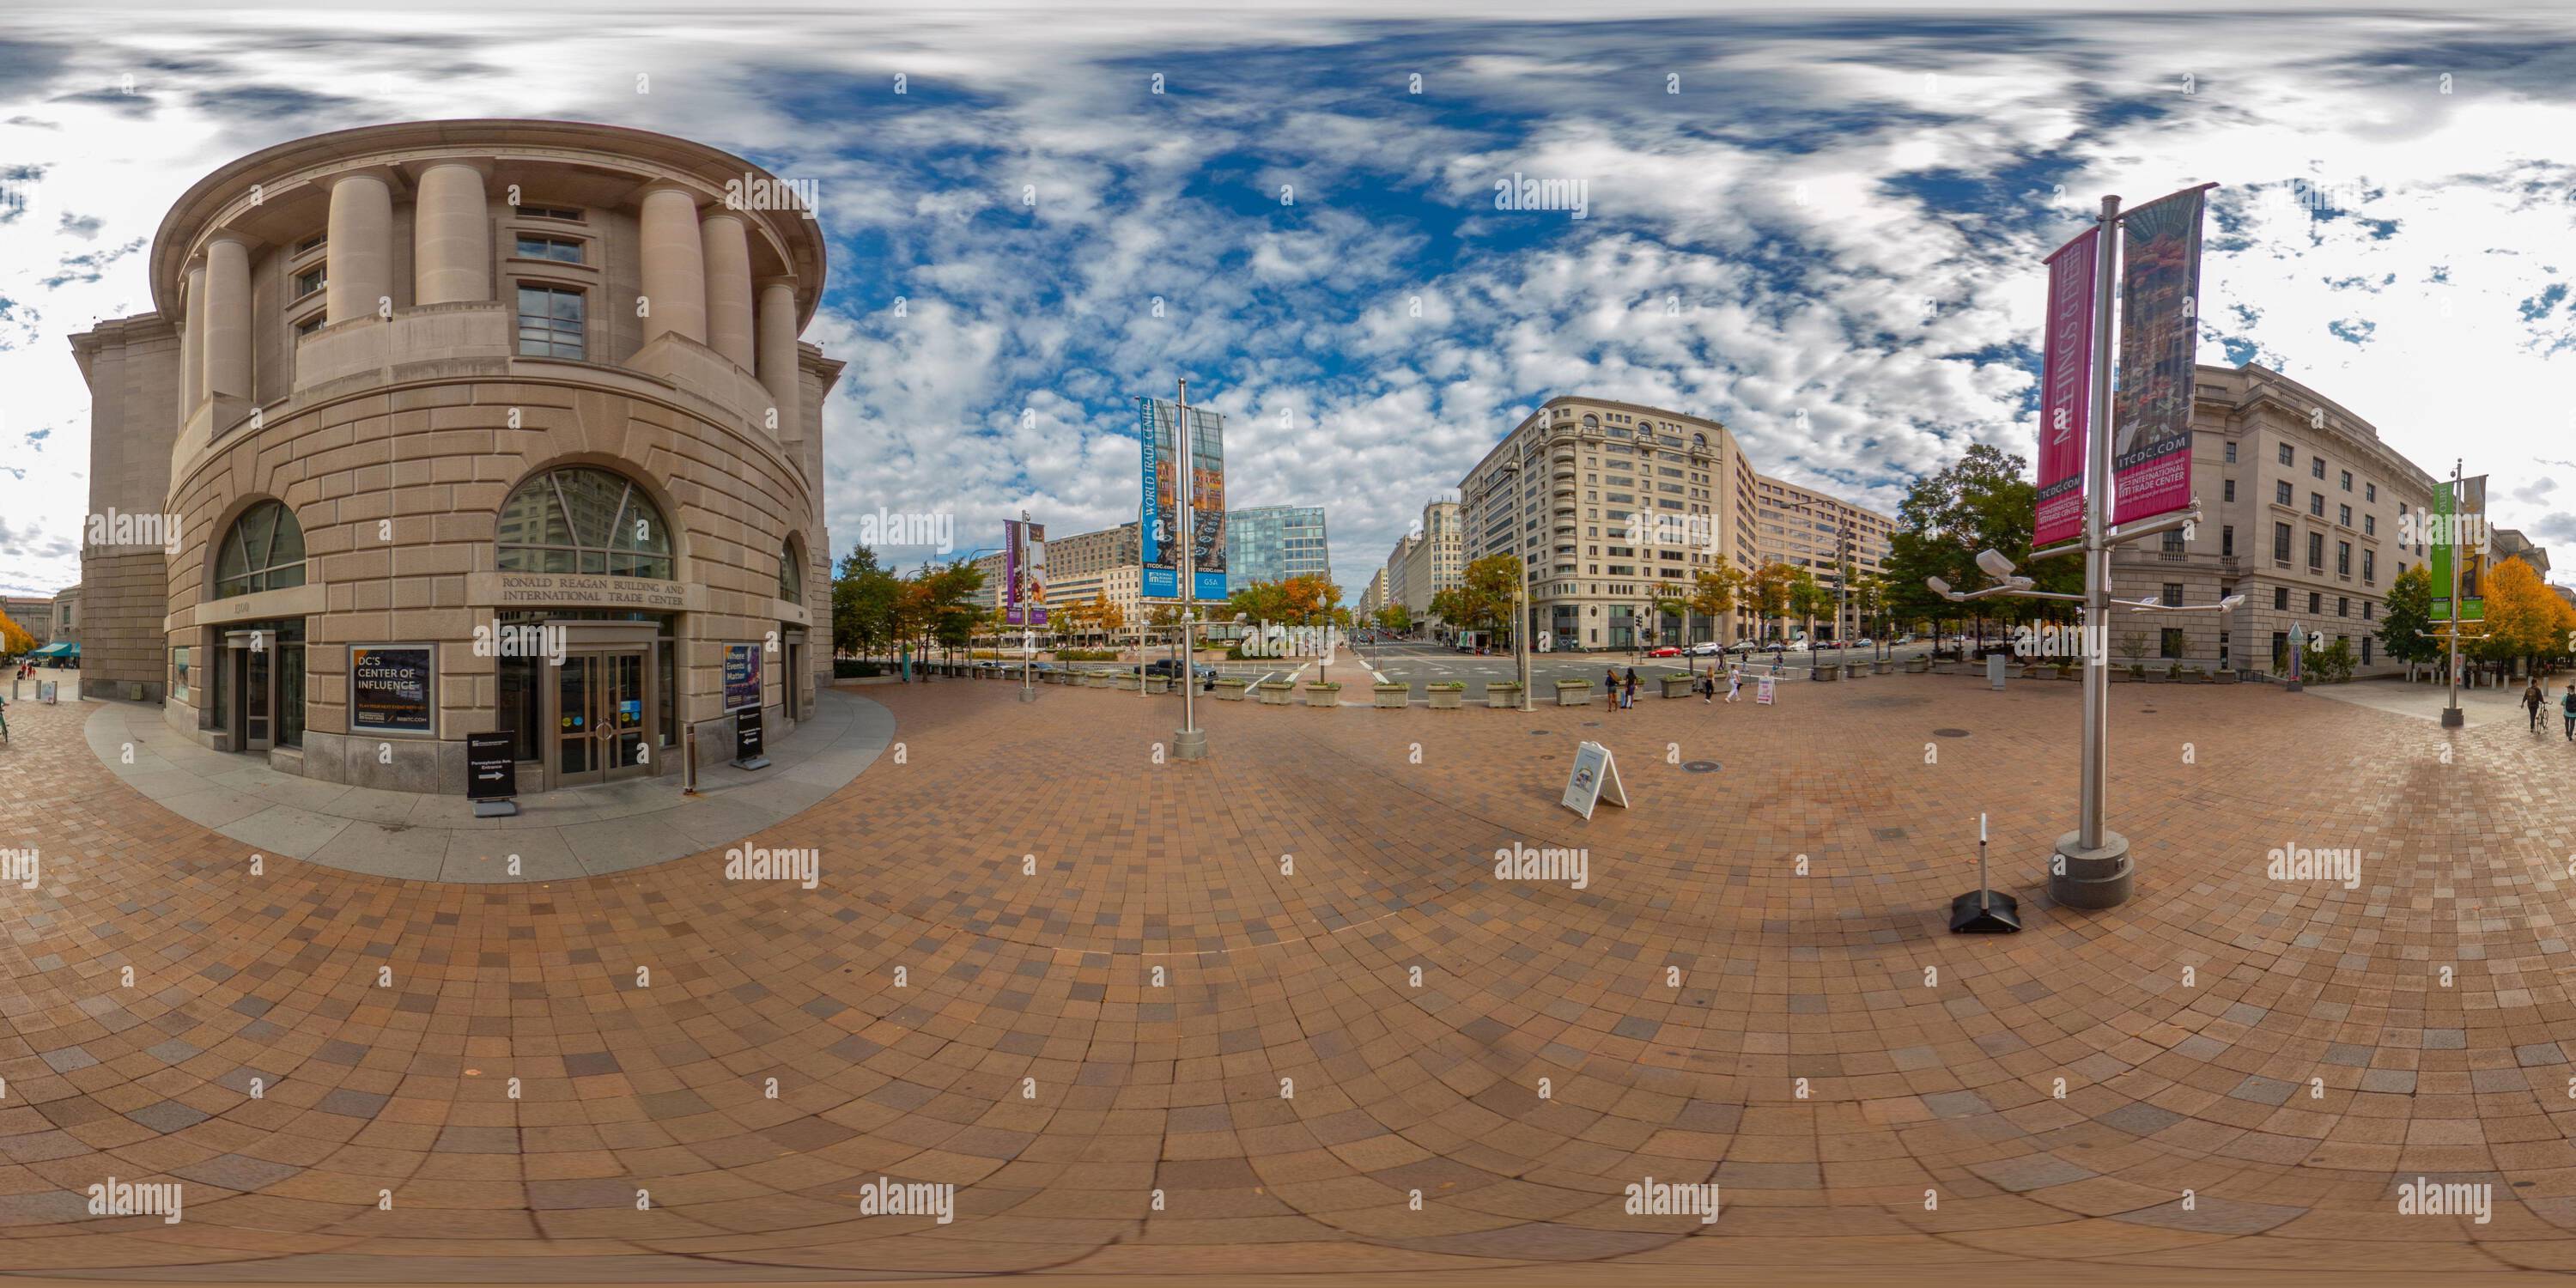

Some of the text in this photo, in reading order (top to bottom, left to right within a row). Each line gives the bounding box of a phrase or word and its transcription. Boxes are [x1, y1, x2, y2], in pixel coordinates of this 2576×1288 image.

[2060, 301, 2078, 320] &
[1144, 442, 1154, 472] TRADE
[2119, 437, 2185, 467] ITCDC.COM
[2132, 463, 2184, 486] INTERNATIONAL
[2132, 471, 2184, 494] TRADE CENTER
[1145, 476, 1155, 515] WORLD
[502, 578, 684, 594] RONALD REAGAN BUILDING AND
[501, 591, 683, 605] INTERNATIONAL TRADE CENTER
[358, 657, 380, 665] DC'S
[358, 669, 415, 677] CENTER OF
[358, 680, 415, 690] INFLUENCE
